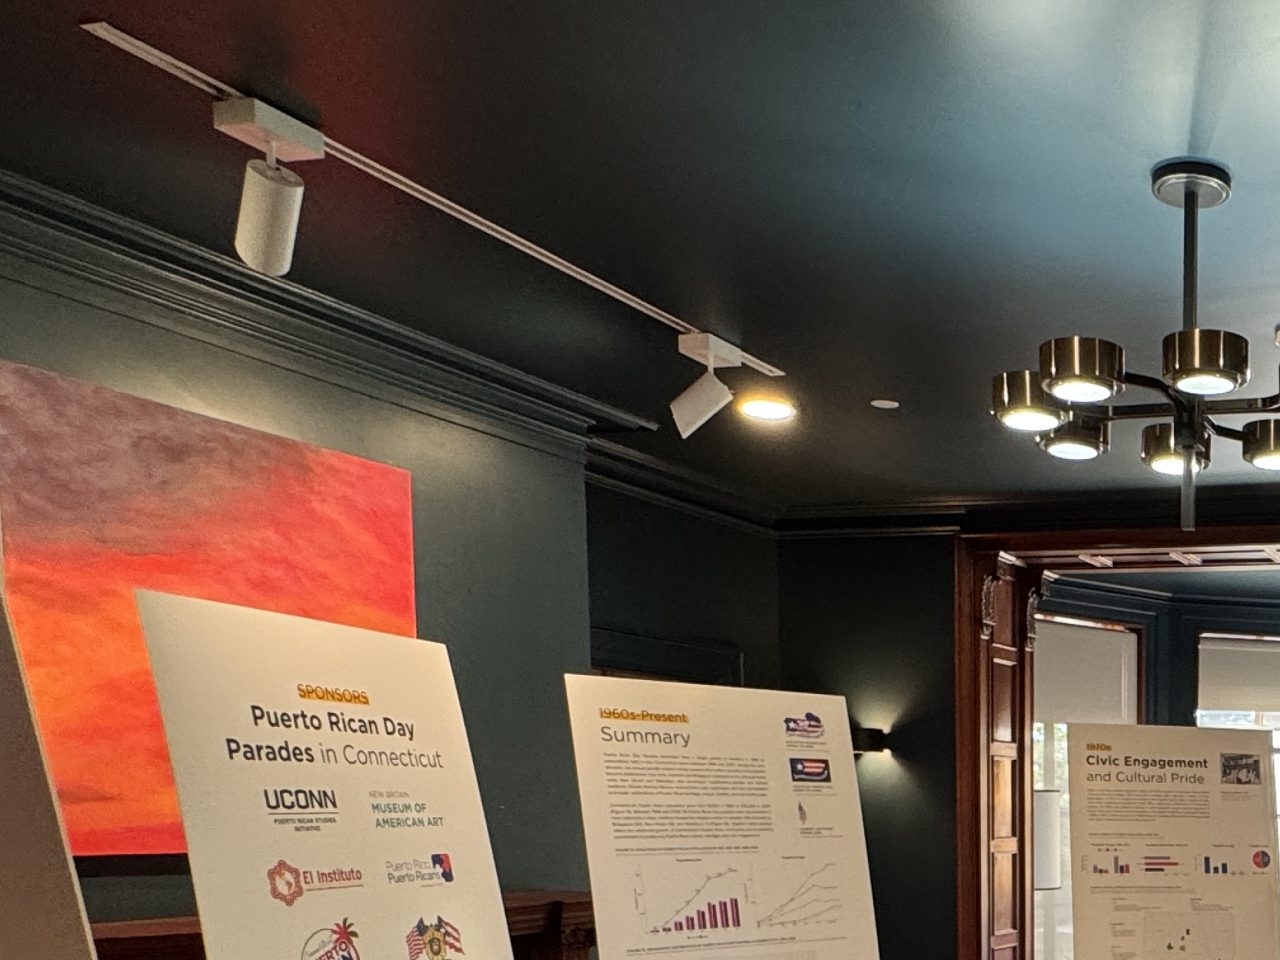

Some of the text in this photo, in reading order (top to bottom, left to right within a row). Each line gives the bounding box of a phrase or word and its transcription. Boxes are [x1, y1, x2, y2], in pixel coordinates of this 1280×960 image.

[298, 684, 370, 705] SPONSORS
[251, 705, 414, 741] Puerto Rican Day
[599, 707, 688, 723] 1960s-Present
[600, 726, 690, 748] Summary
[226, 738, 444, 769] Parades in Connecticut
[1086, 754, 1208, 769] Civic Engagement
[1086, 771, 1205, 785] and Cultural Pride
[264, 789, 338, 810] UCONN
[371, 802, 426, 814] MUSEUM OF
[376, 816, 443, 828] AMERICAN ART
[385, 860, 412, 872] Puerto
[303, 868, 362, 885] El Instituto
[388, 872, 415, 884] Puerto
